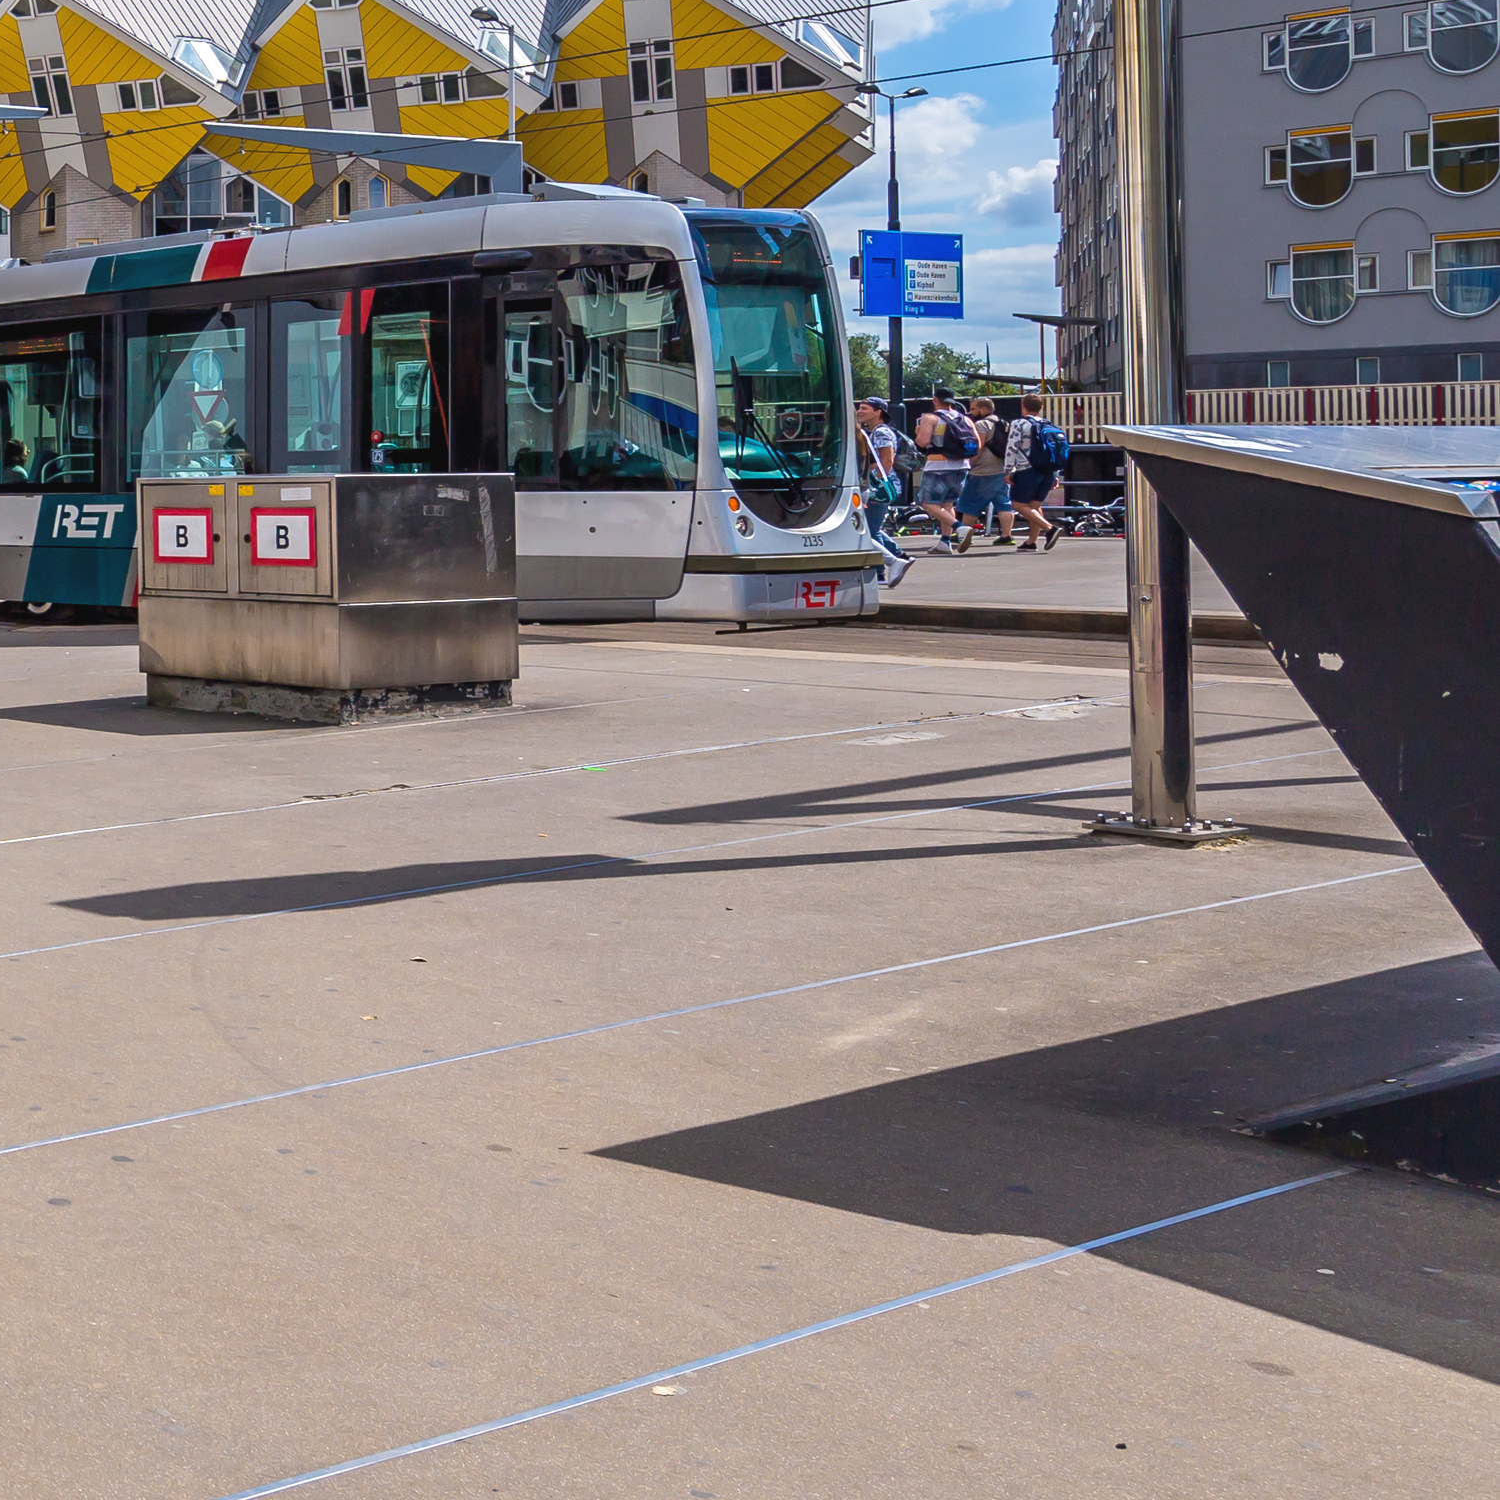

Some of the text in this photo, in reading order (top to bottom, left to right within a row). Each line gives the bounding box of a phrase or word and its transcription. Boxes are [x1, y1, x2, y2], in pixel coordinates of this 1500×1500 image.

[52, 504, 125, 538] RET
[176, 525, 189, 548] B
[276, 525, 290, 549] B
[802, 535, 824, 547] 2135
[794, 580, 841, 609] RET
